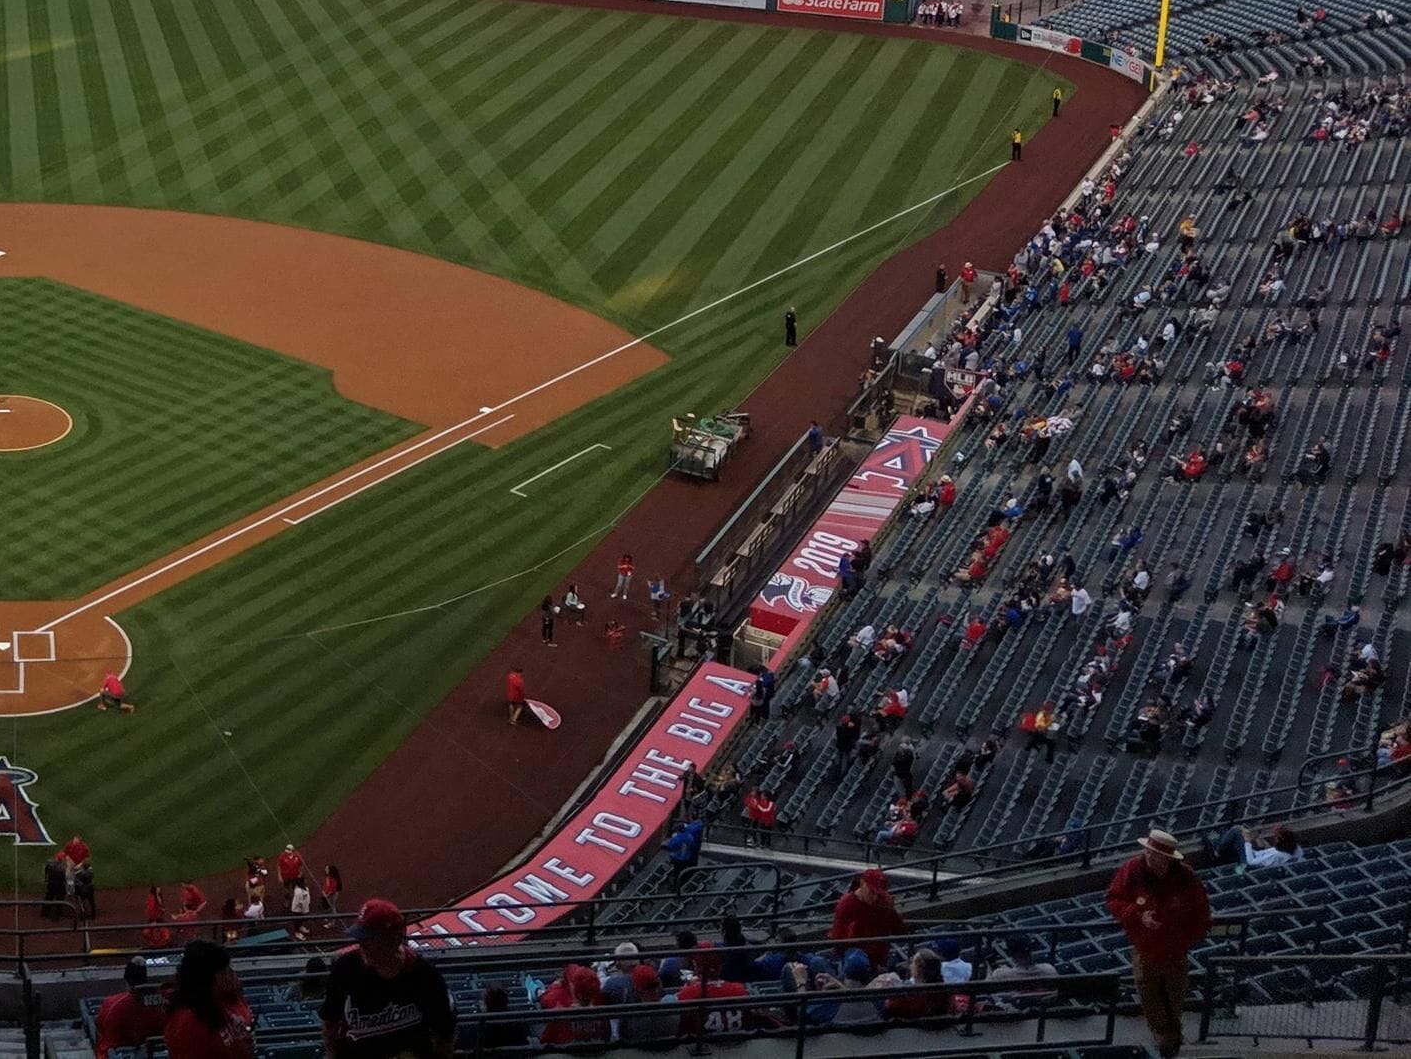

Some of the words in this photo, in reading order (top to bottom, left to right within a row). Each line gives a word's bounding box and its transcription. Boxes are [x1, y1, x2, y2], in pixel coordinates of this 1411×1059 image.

[793, 531, 859, 579] 2019
[575, 811, 642, 854] TO
[619, 748, 693, 803] THE
[666, 697, 734, 745] BIG
[705, 674, 754, 696] A
